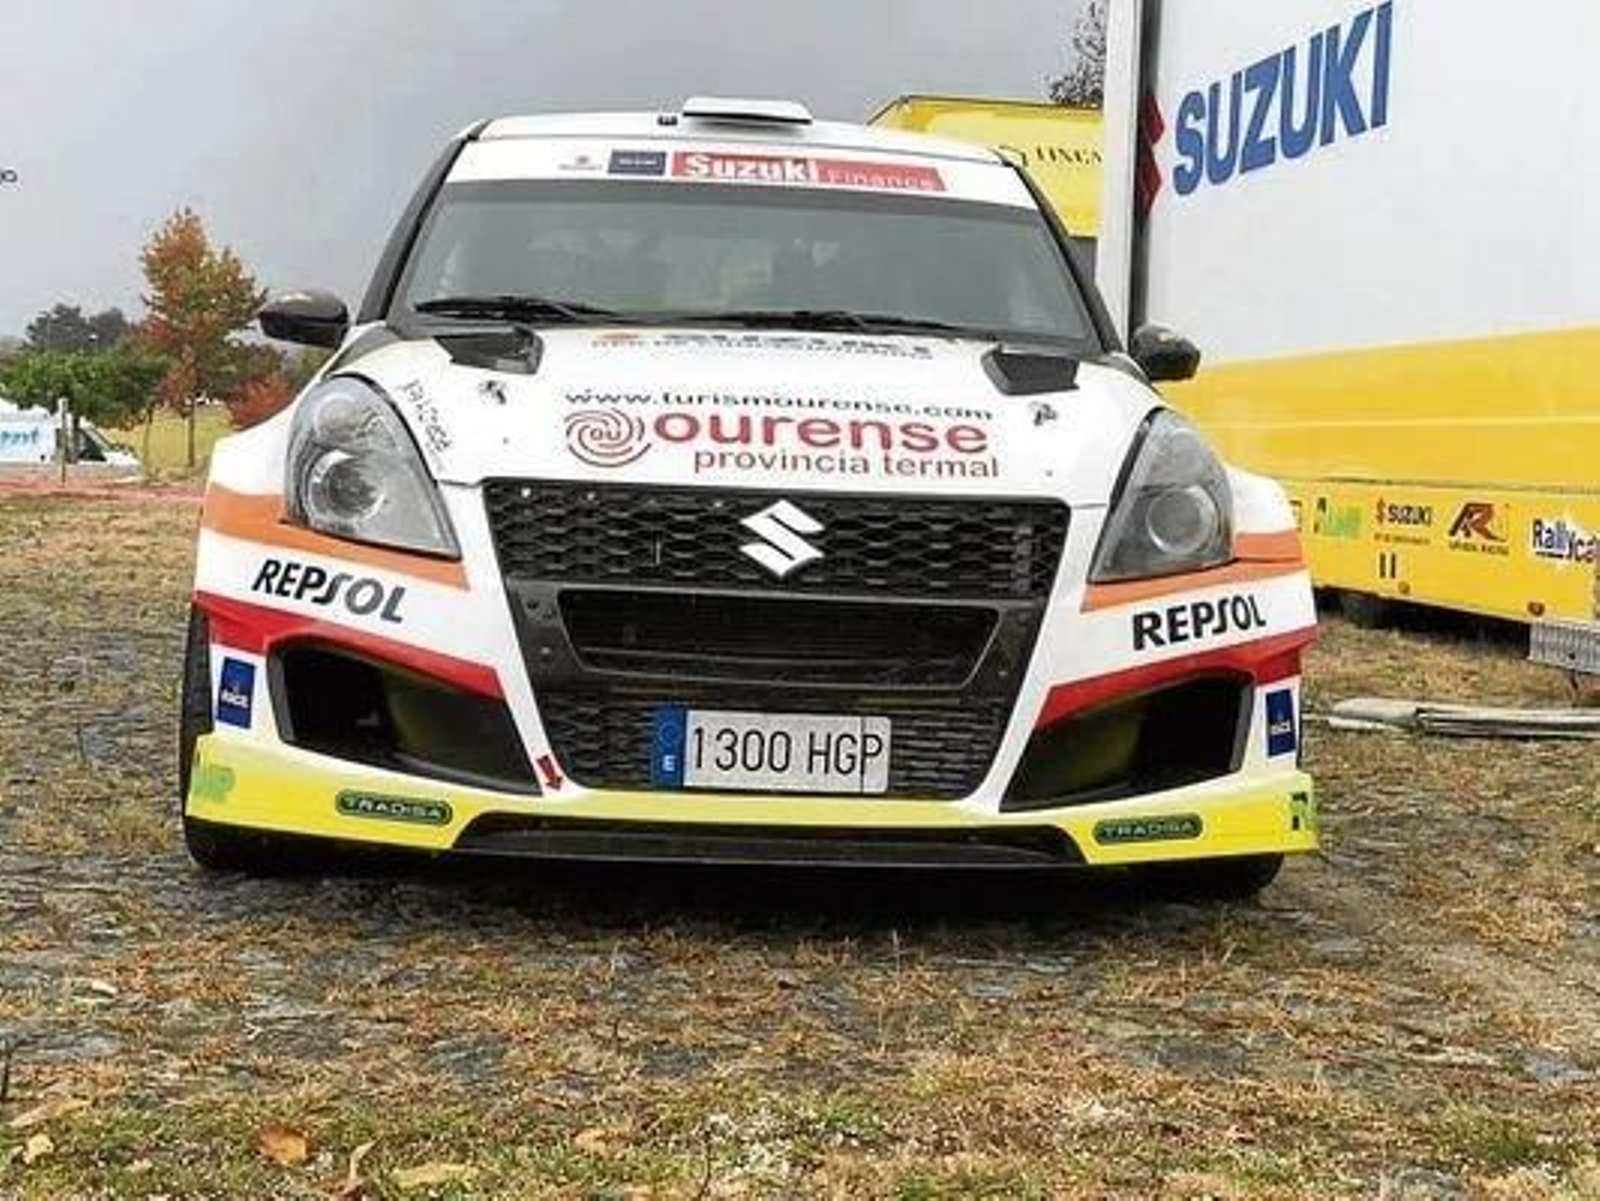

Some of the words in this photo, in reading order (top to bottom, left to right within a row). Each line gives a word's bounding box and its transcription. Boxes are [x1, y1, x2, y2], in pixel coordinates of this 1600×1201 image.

[1173, 0, 1393, 196] SUZUKI
[685, 153, 817, 184] Suzuki
[653, 411, 988, 453] ourense
[695, 448, 870, 474] provincia
[883, 450, 998, 477] termal
[252, 558, 406, 624] REPSOL
[1132, 594, 1267, 651] REPSOL
[662, 754, 676, 772] E
[694, 725, 793, 772] 1300
[807, 731, 884, 776] HGP
